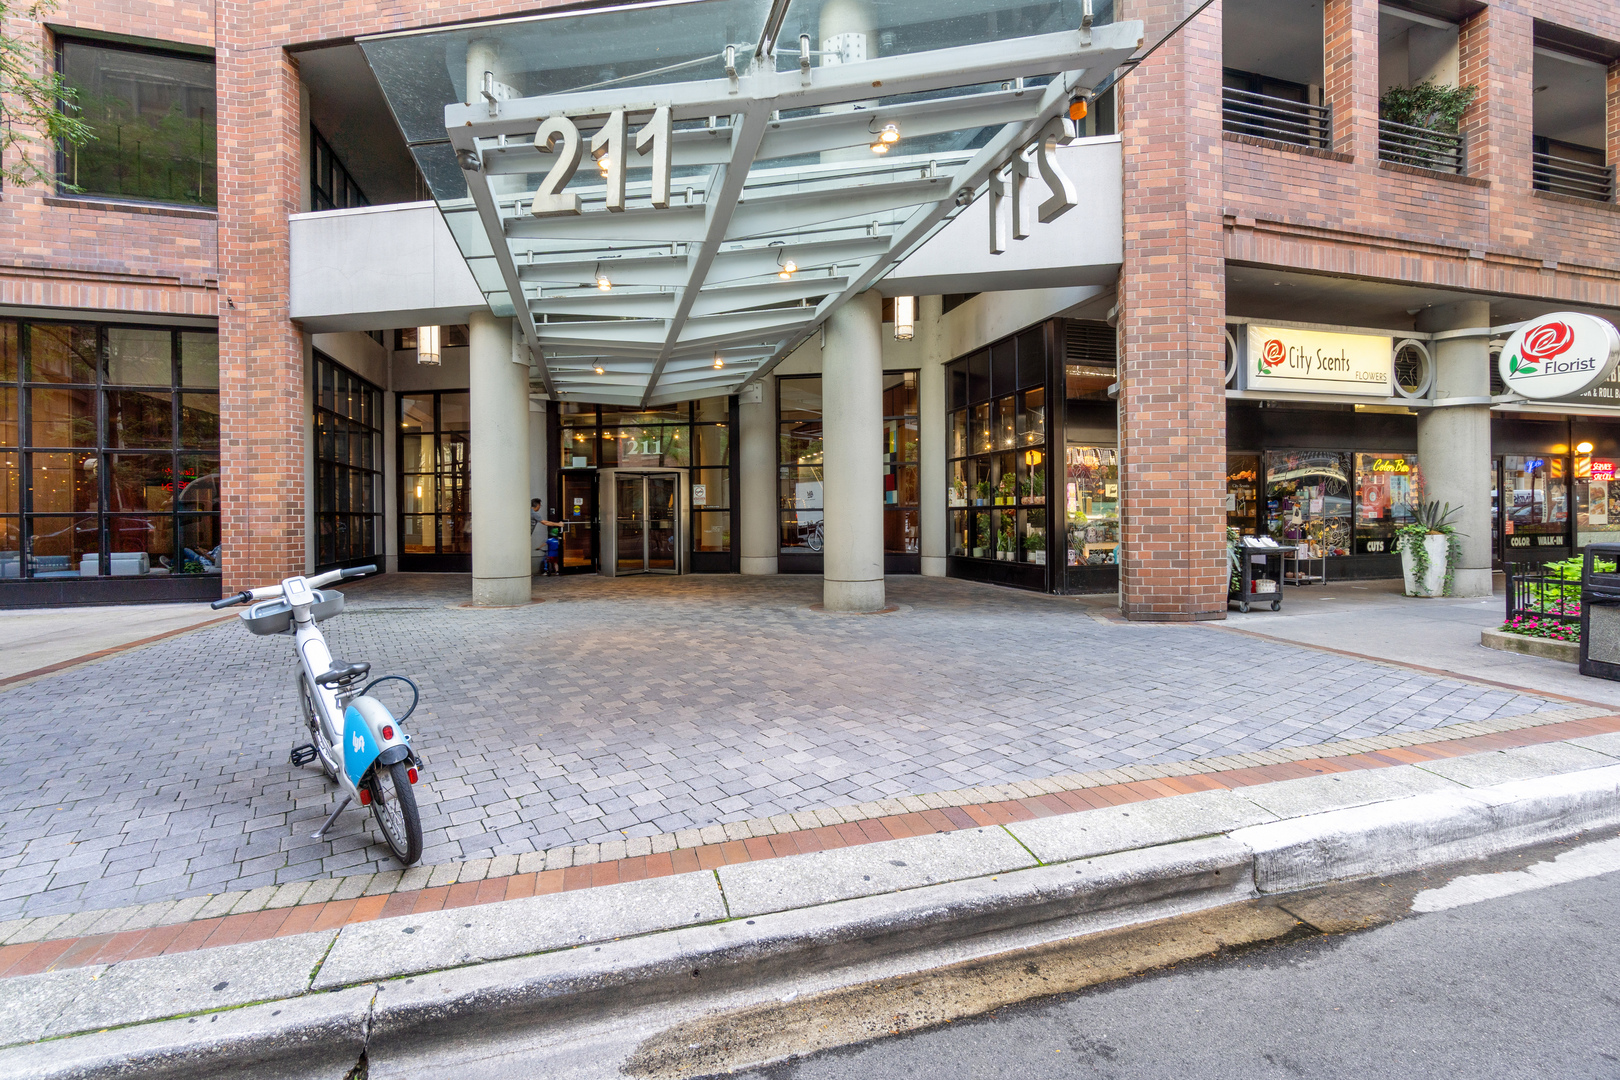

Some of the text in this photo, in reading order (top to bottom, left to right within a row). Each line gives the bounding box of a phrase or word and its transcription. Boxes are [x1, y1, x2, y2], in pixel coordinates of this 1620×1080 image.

[531, 106, 673, 218] 211
[1289, 345, 1350, 374] City Scents
[1545, 357, 1596, 374] Florist
[1355, 370, 1387, 381] FLOWERS
[1599, 387, 1613, 398] ROLL
[627, 440, 663, 455] 211
[1373, 458, 1410, 472] Color Bar
[1367, 541, 1384, 552] CUTS
[1511, 536, 1563, 547] COLOR WALK-IN
